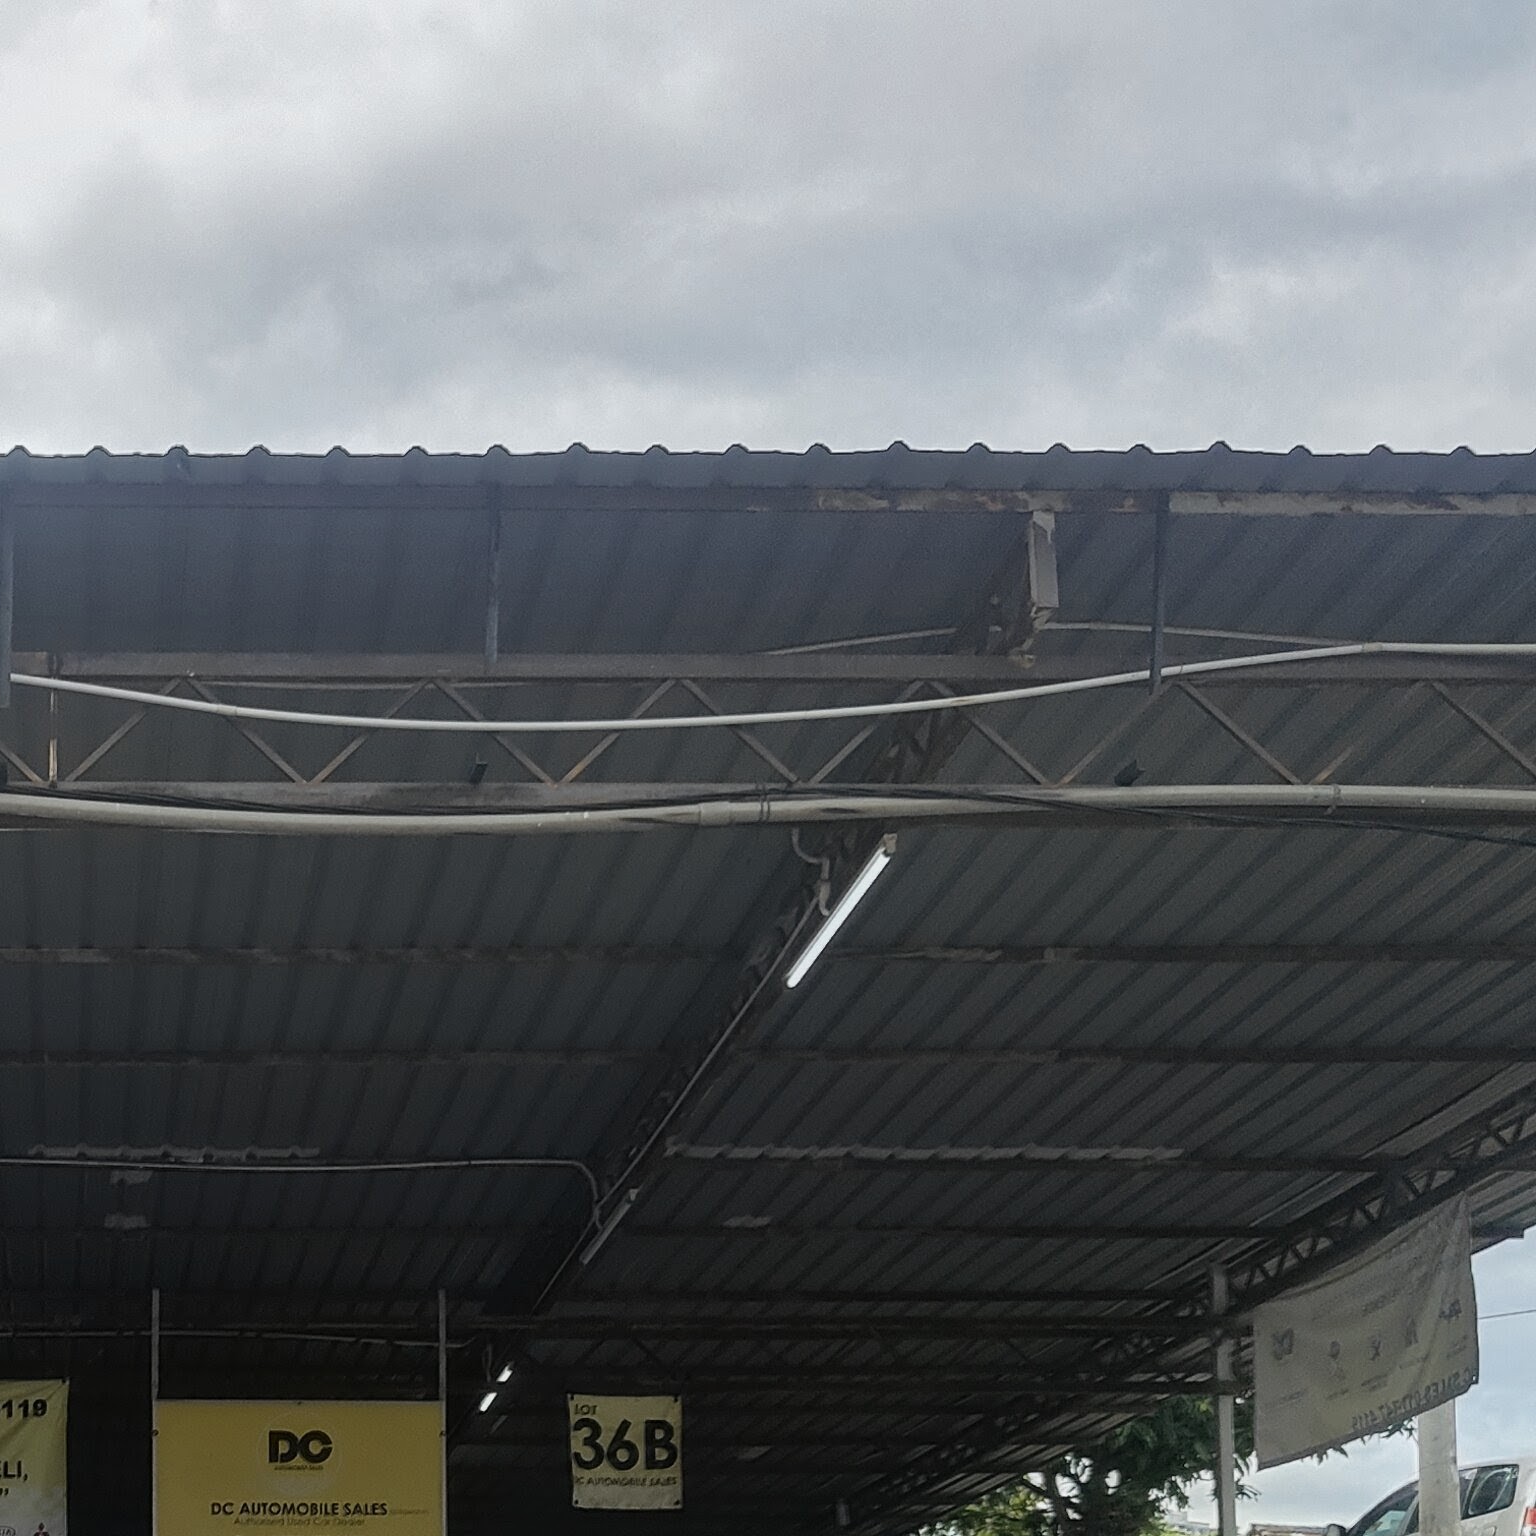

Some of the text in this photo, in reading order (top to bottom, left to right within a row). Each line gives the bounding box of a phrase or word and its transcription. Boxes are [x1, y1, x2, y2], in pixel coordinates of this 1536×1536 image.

[575, 1404, 597, 1415] LOT
[269, 1430, 333, 1464] DC
[573, 1417, 678, 1471] 36B
[211, 1503, 233, 1515] DC
[239, 1503, 339, 1516] AUTOMOBILE
[343, 1503, 387, 1516] SALES
